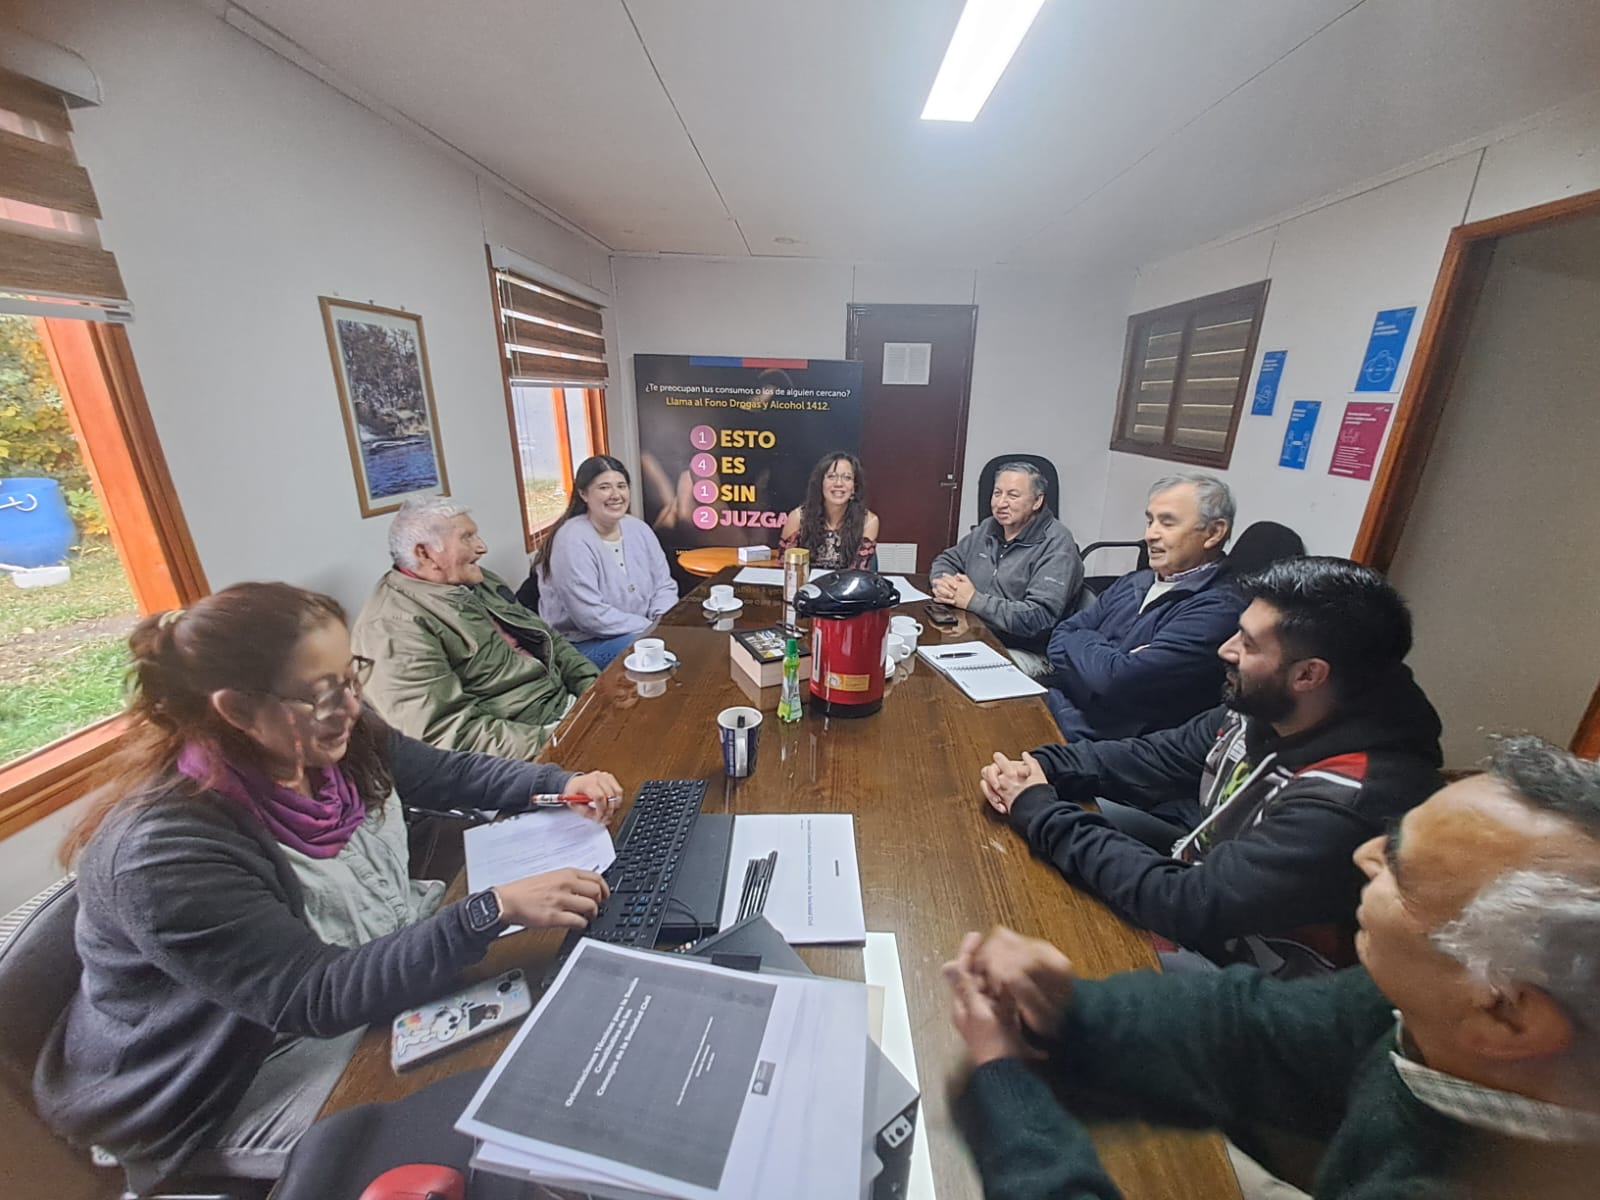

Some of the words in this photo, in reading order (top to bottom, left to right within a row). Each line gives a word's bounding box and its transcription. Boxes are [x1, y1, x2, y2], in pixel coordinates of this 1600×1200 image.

[645, 383, 658, 393] ¿Te
[660, 384, 700, 393] preocupan
[715, 387, 753, 395] consumos
[762, 387, 773, 395] los
[775, 388, 784, 396] de
[787, 389, 814, 398] alguien
[816, 389, 850, 398] cercano?
[666, 397, 693, 406] Llama
[694, 398, 703, 407] al
[705, 398, 728, 408] Fono
[730, 399, 760, 410] Drogas
[770, 401, 805, 410] Alcohol
[806, 402, 830, 411] 1412.
[720, 430, 776, 448] ESTO
[721, 456, 746, 474] ES
[721, 484, 756, 502] SIN
